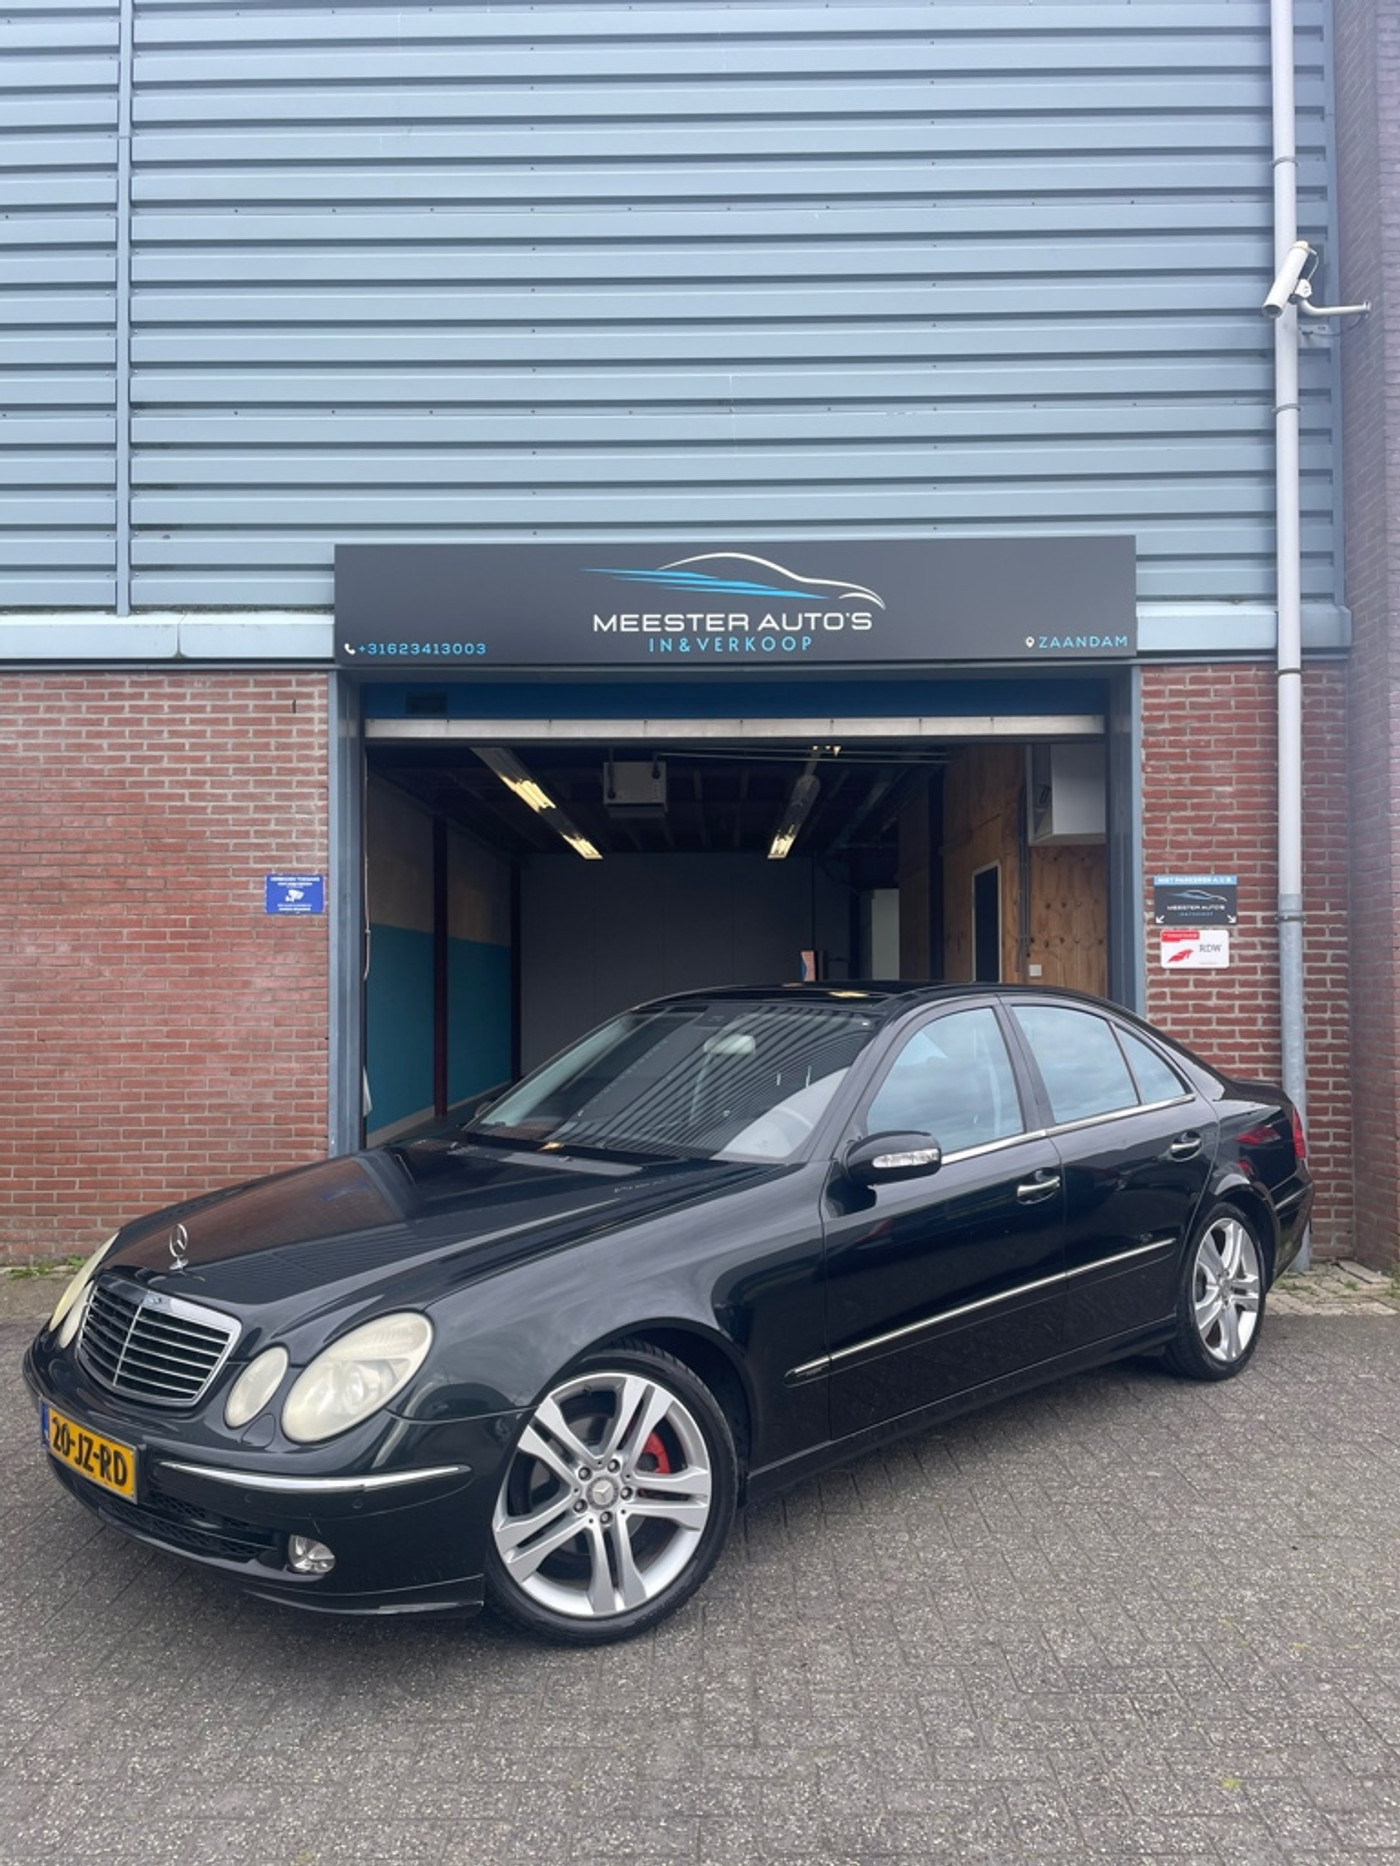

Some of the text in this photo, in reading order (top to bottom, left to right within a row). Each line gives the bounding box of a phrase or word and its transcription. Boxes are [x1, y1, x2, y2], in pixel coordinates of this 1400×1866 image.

[593, 612, 873, 632] MEESTER AUTO'S
[359, 643, 487, 655] +31623413003
[1038, 635, 1128, 649] ZAANDAM
[1199, 944, 1222, 953] RDW
[52, 1416, 128, 1487] 20-JZ-RD
